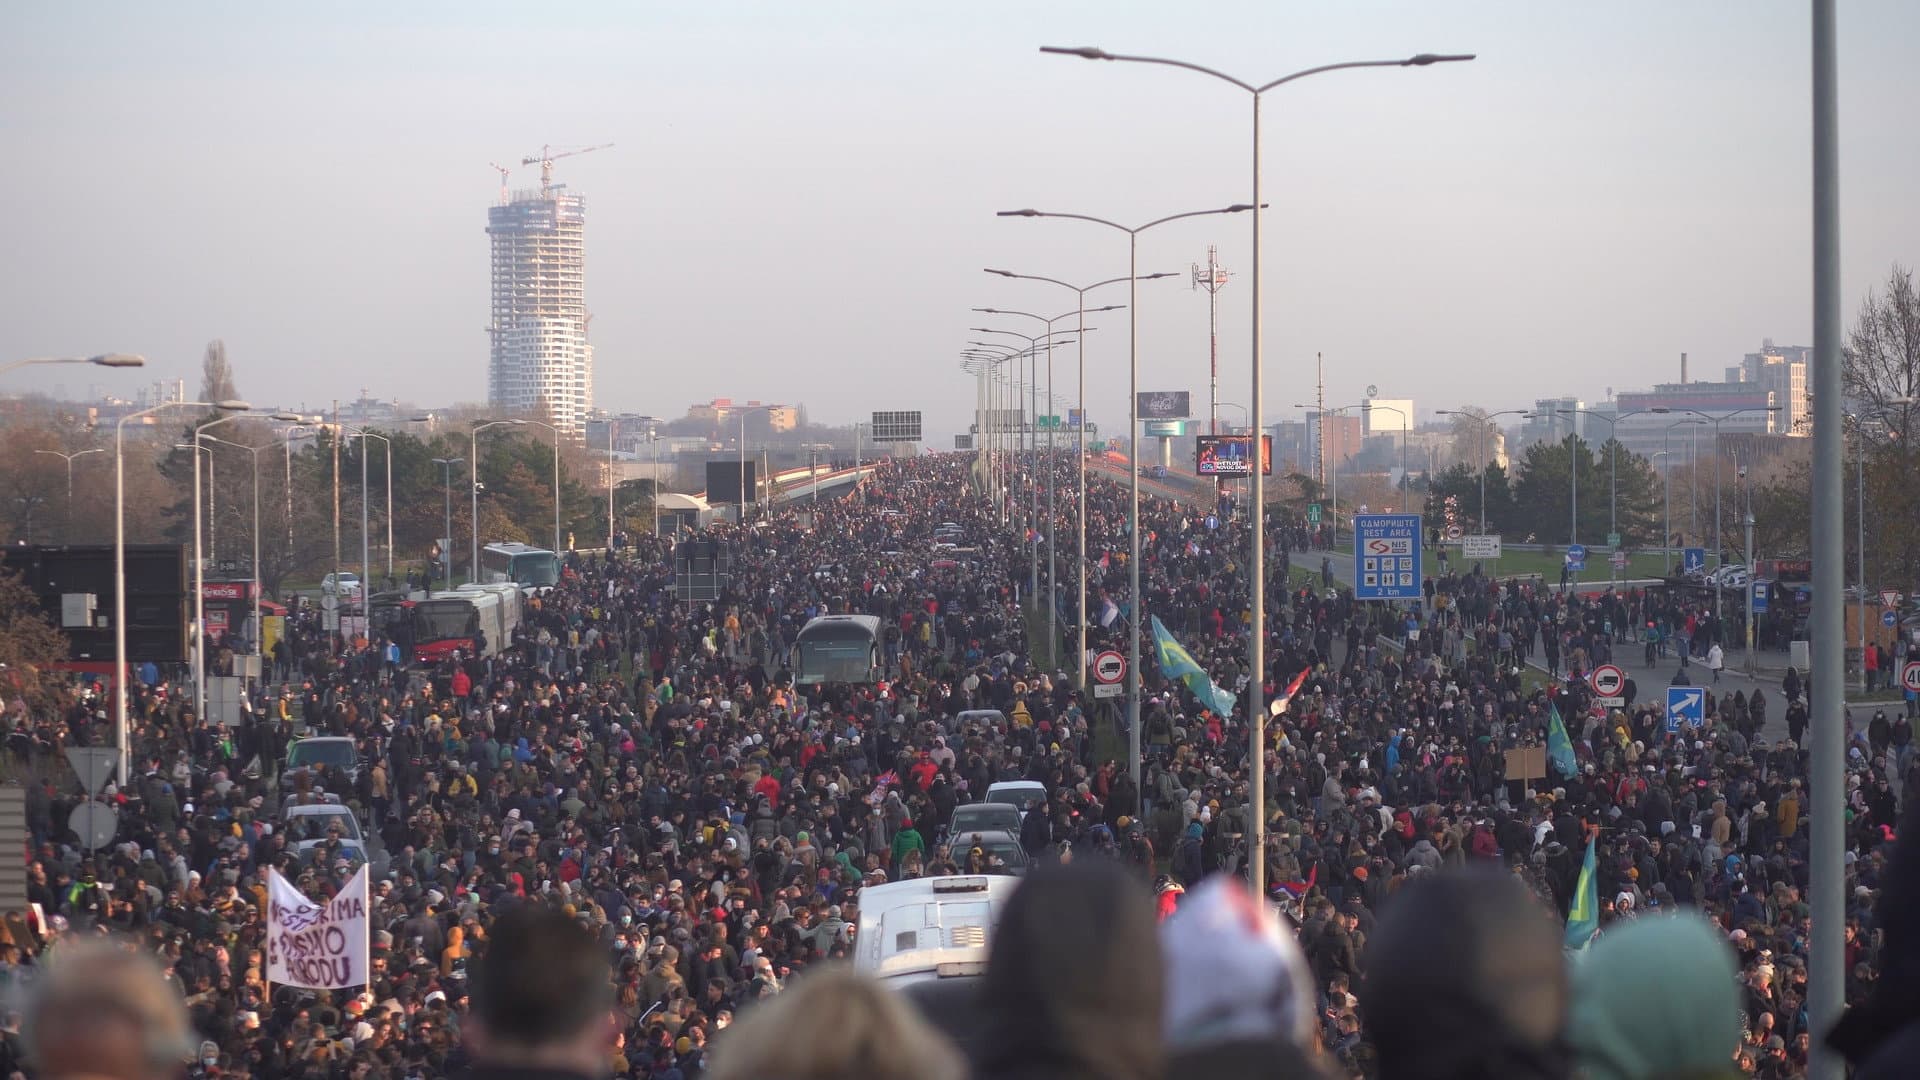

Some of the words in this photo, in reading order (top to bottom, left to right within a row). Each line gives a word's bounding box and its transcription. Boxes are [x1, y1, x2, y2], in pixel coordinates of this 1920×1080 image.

[1361, 519, 1414, 528] ОДМОРИШТЕ
[1364, 529, 1384, 537] REST
[1390, 529, 1411, 537] AREA
[1377, 588, 1384, 596] 2
[1387, 588, 1399, 596] km
[1669, 717, 1700, 728] IZAZ
